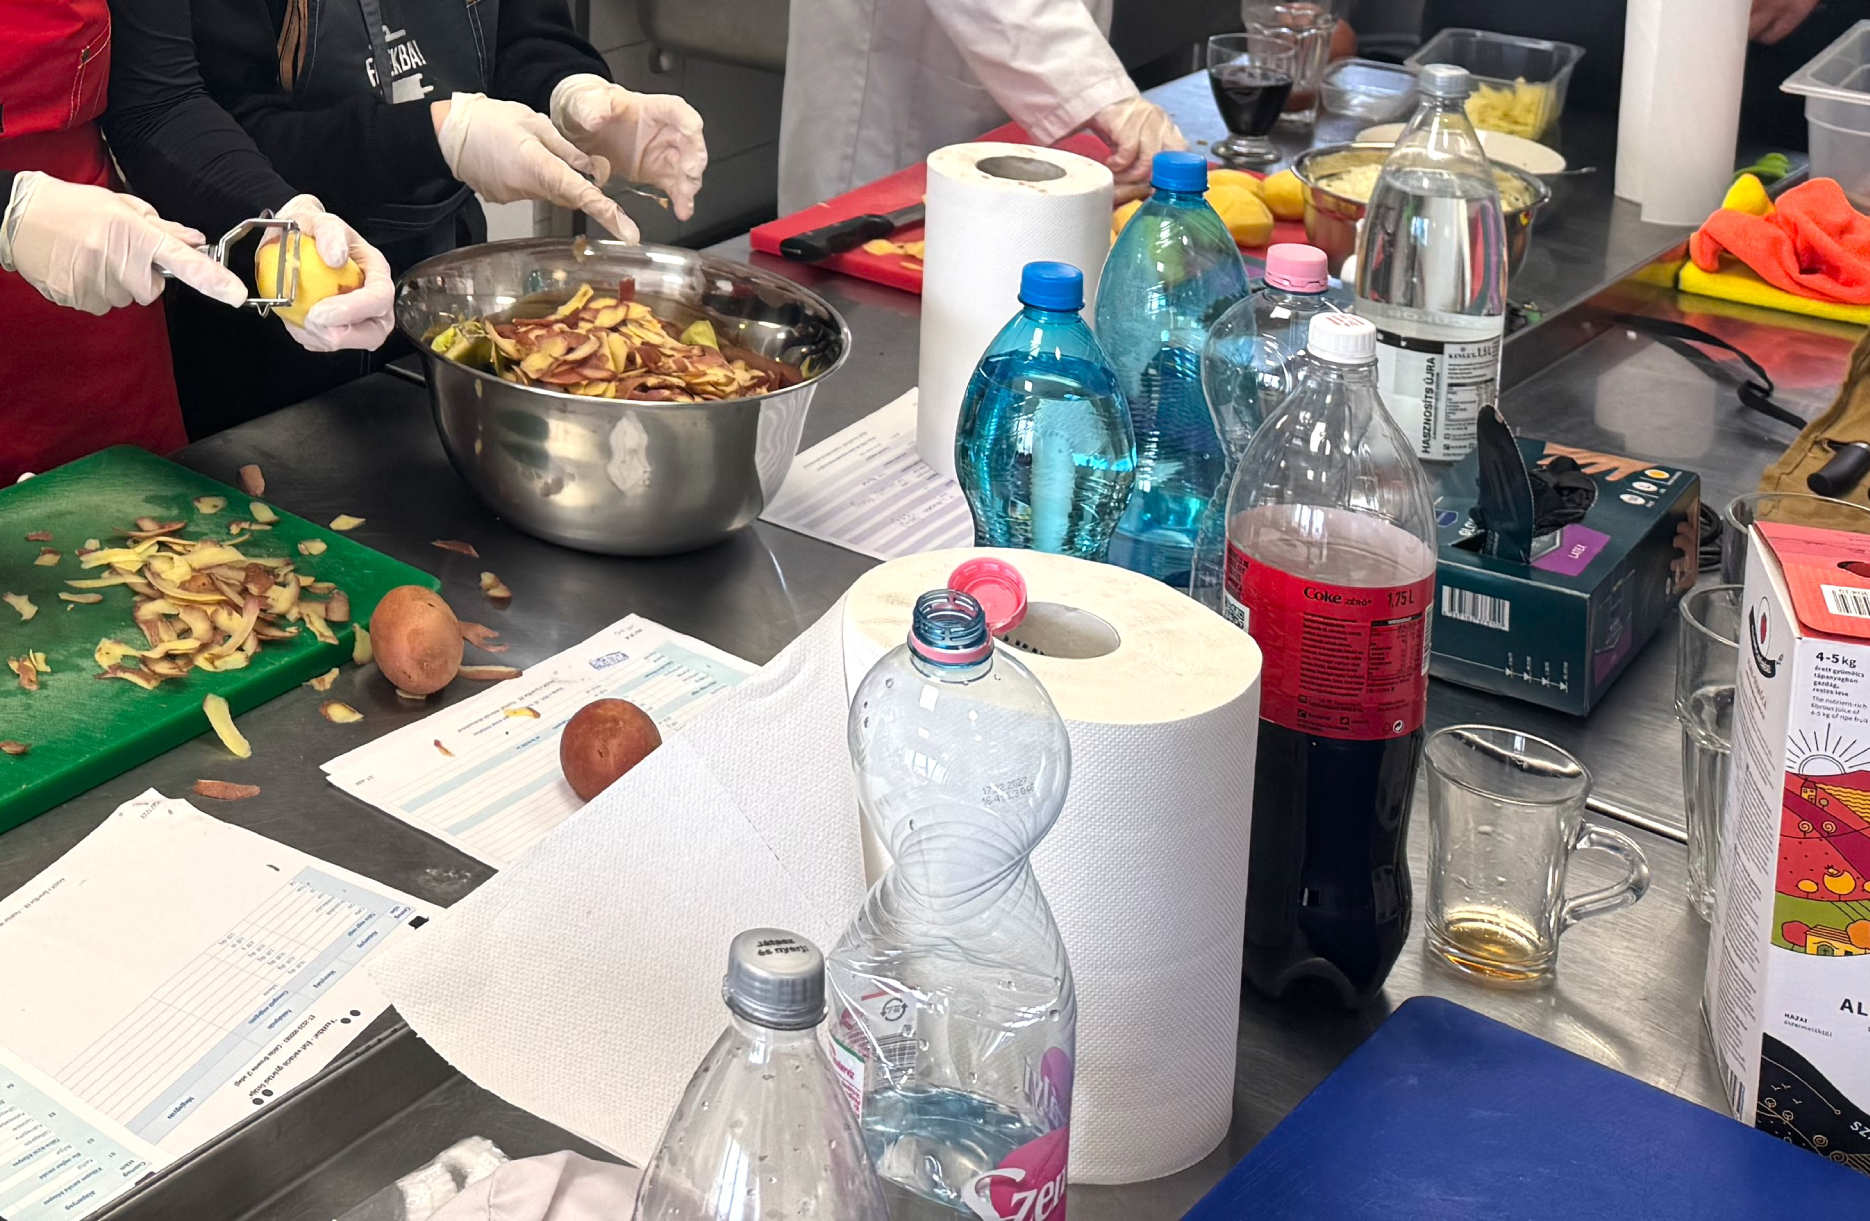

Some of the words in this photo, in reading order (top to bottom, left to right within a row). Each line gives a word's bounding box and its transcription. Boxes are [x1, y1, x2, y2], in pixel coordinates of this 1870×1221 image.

[1423, 357, 1436, 385] ÚJRA
[1421, 389, 1434, 453] HASZNOSÍTS
[1568, 544, 1587, 559] LATEX
[1303, 586, 1342, 605] Coke
[1815, 652, 1840, 664] 4-5
[1842, 655, 1857, 668] kg
[1814, 672, 1858, 684] tápanyagban
[1832, 668, 1865, 678] gyümölcs
[1824, 697, 1868, 709] nutrient-rich
[1835, 706, 1851, 714] juice
[1840, 714, 1852, 723] ripe
